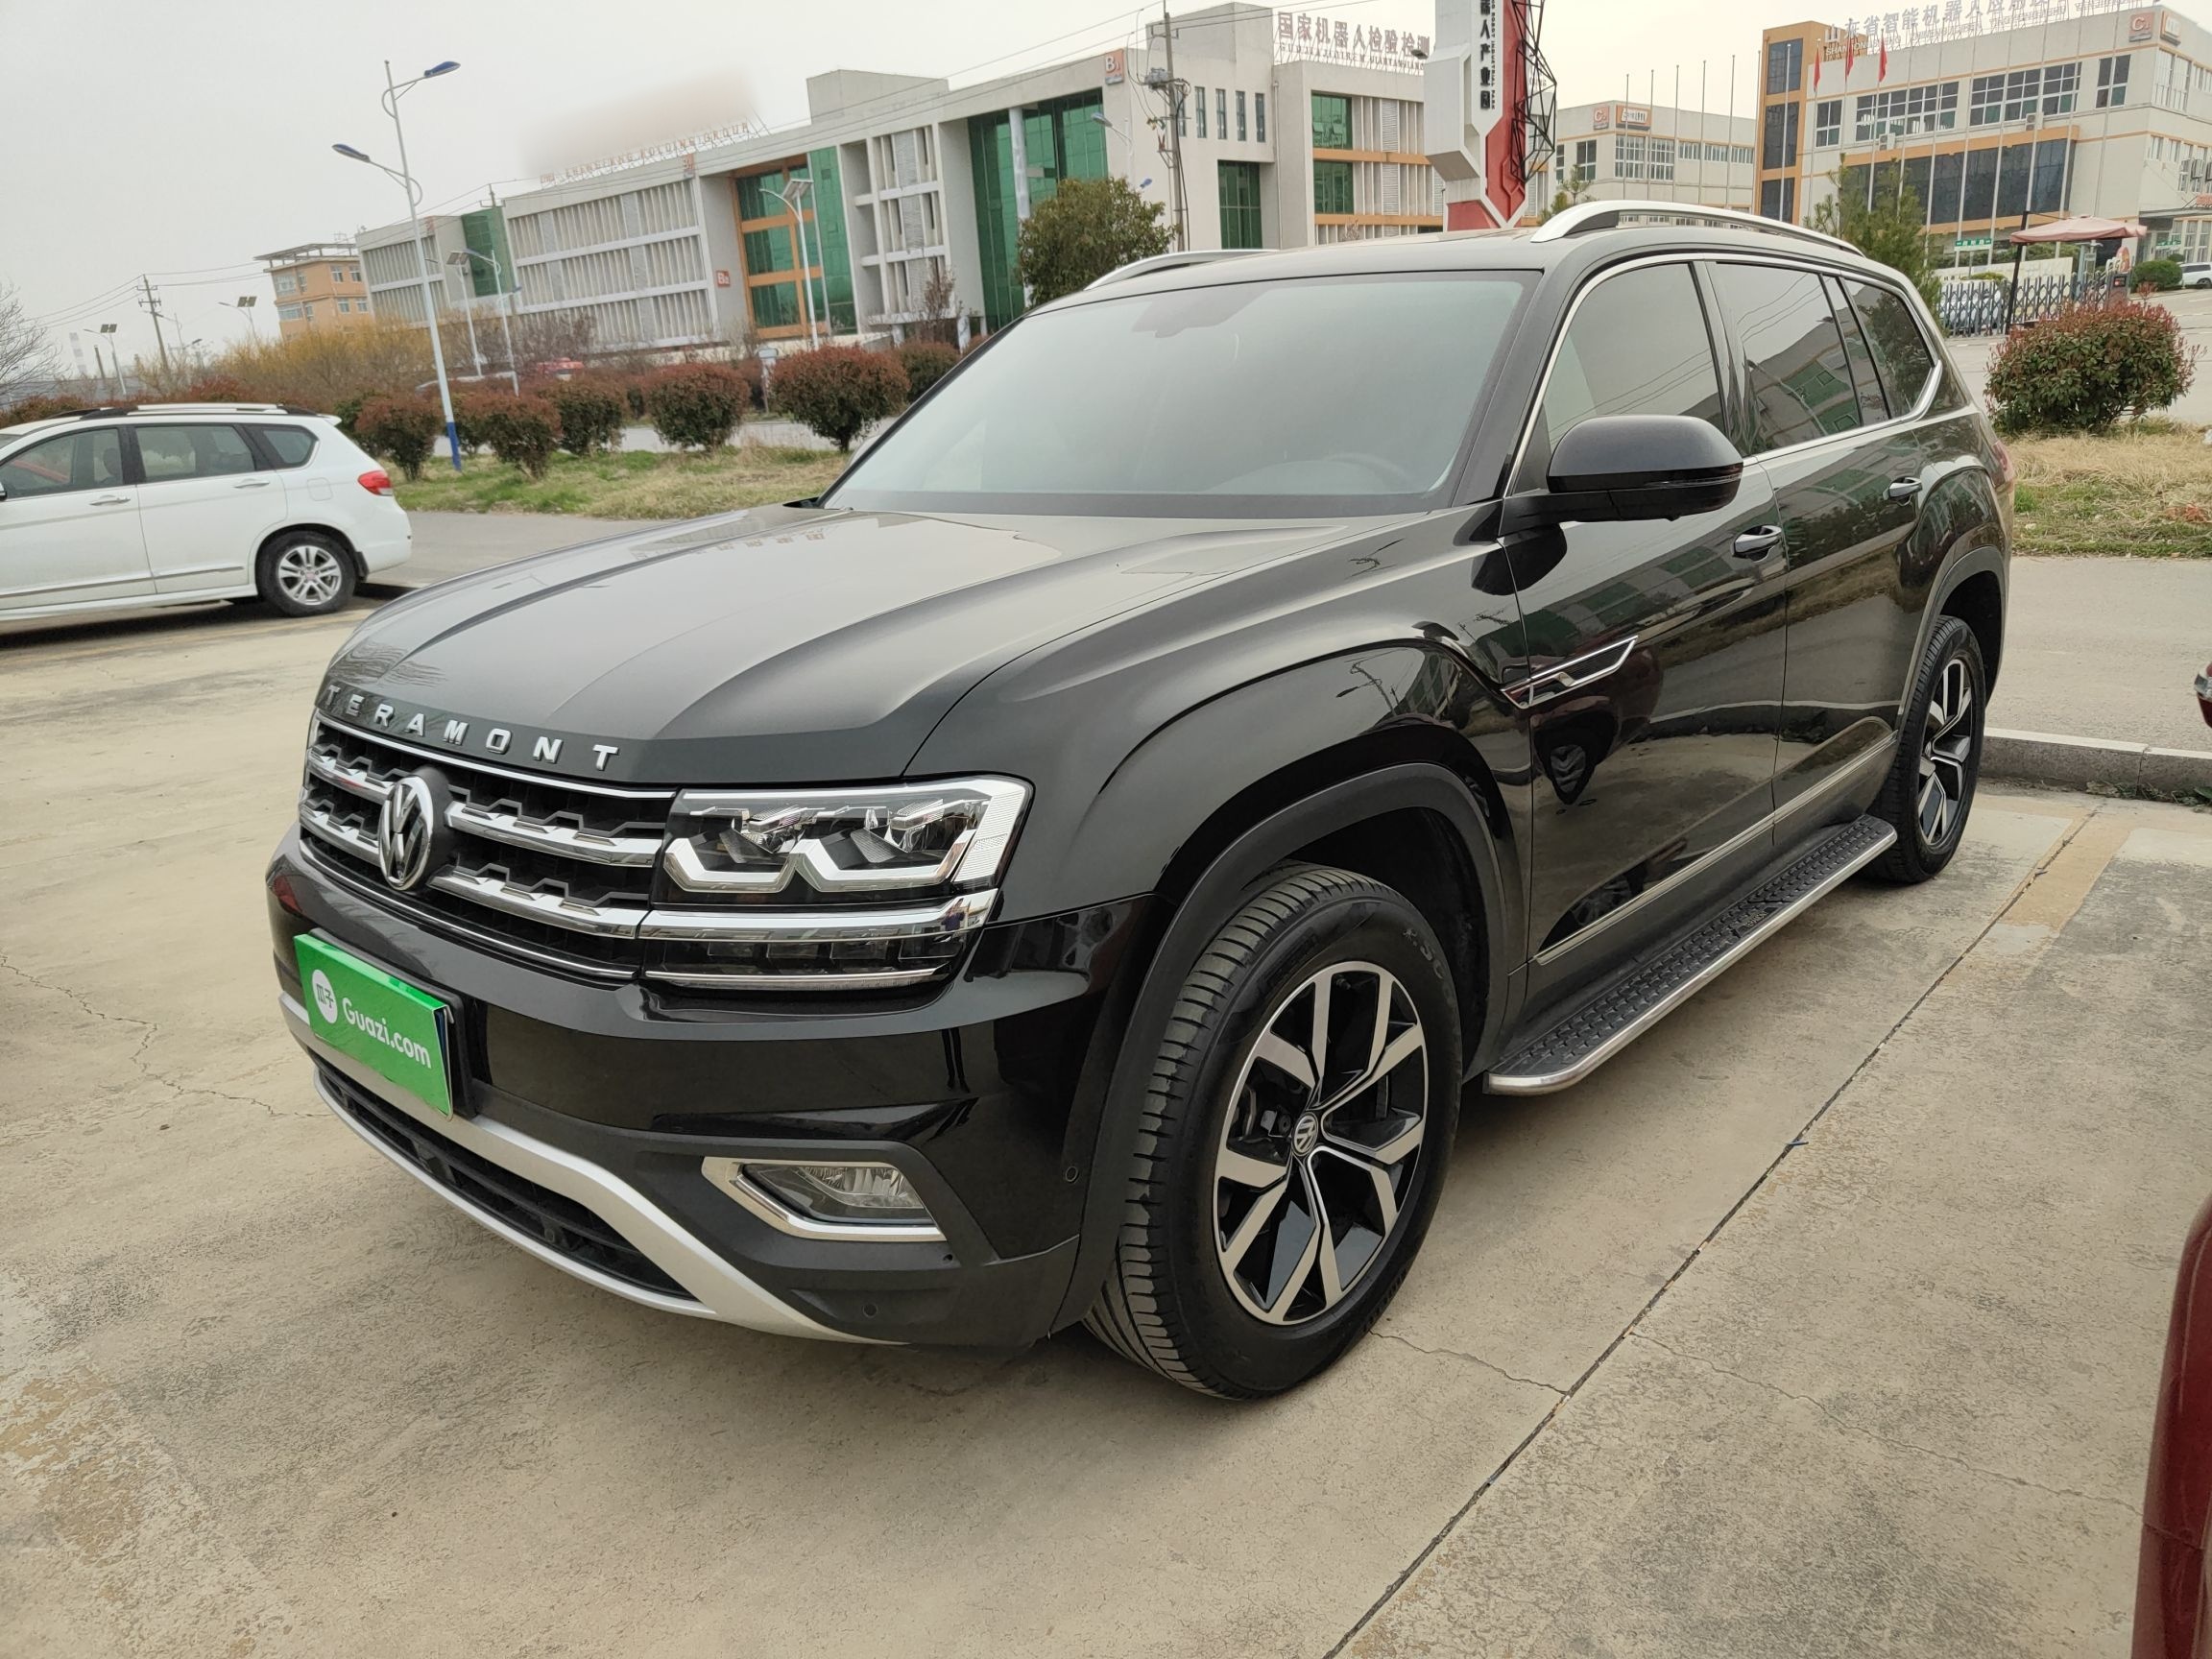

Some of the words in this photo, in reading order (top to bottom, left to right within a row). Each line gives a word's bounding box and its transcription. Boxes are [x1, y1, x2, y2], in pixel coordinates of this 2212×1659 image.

[326, 684, 620, 771] TERAMONT
[316, 983, 335, 1009] 瓜子
[342, 997, 432, 1069] Guazi.com
